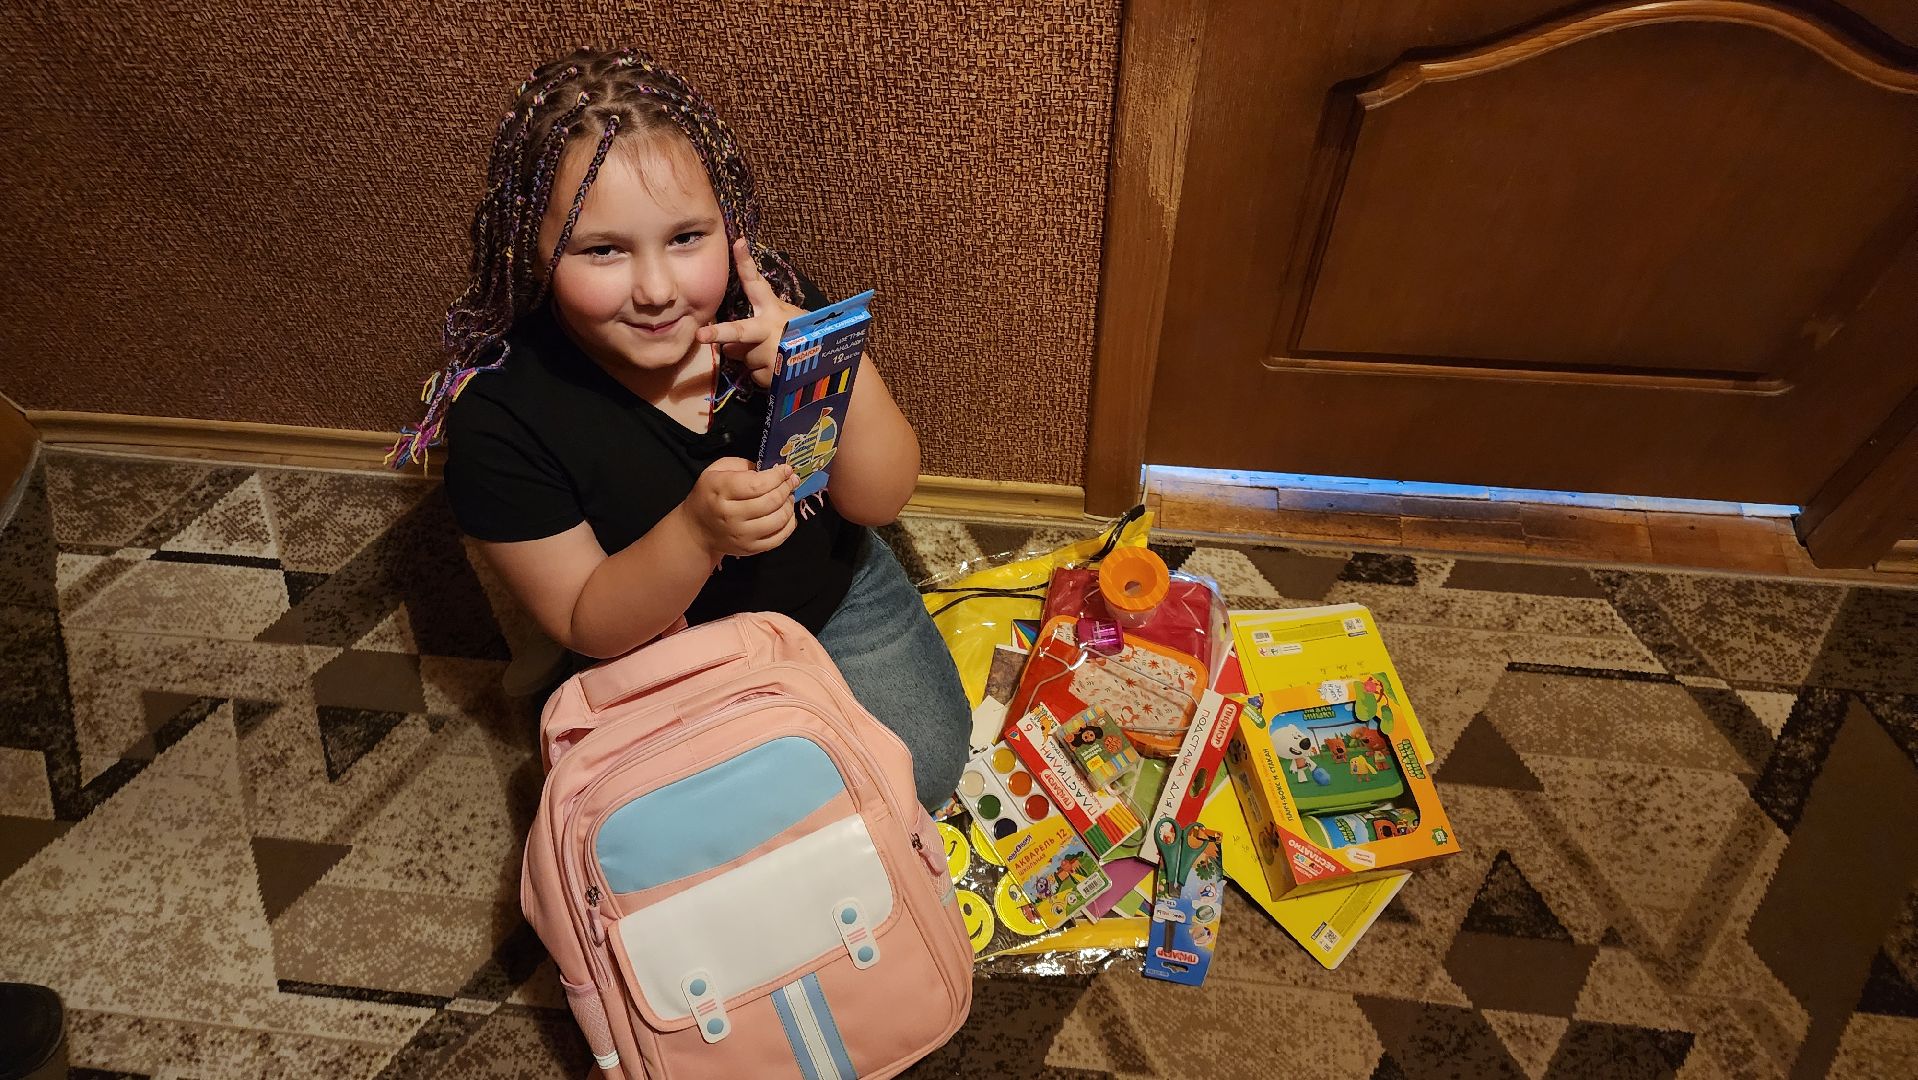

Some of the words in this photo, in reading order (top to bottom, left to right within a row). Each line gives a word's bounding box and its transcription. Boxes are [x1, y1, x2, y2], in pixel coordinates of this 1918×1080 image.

[1023, 722, 1033, 732] 6
[1214, 704, 1234, 746] ПИФАГОР
[1175, 708, 1211, 778] ПОДСТАВКА
[1263, 748, 1276, 774] СТАКАН
[1040, 745, 1098, 816] ПЛАСТИЛИН
[1044, 772, 1072, 807] ПИФАГОР
[1164, 780, 1180, 809] ДЛЯ
[1275, 781, 1294, 822] ЛАНЧ-БОКС
[1014, 837, 1055, 870] АКВАРЕЛЬ
[1056, 828, 1068, 839] 12
[1018, 854, 1046, 876] ШКОЛЬНАЯ
[1288, 838, 1336, 873] БЕСПЛАТНО
